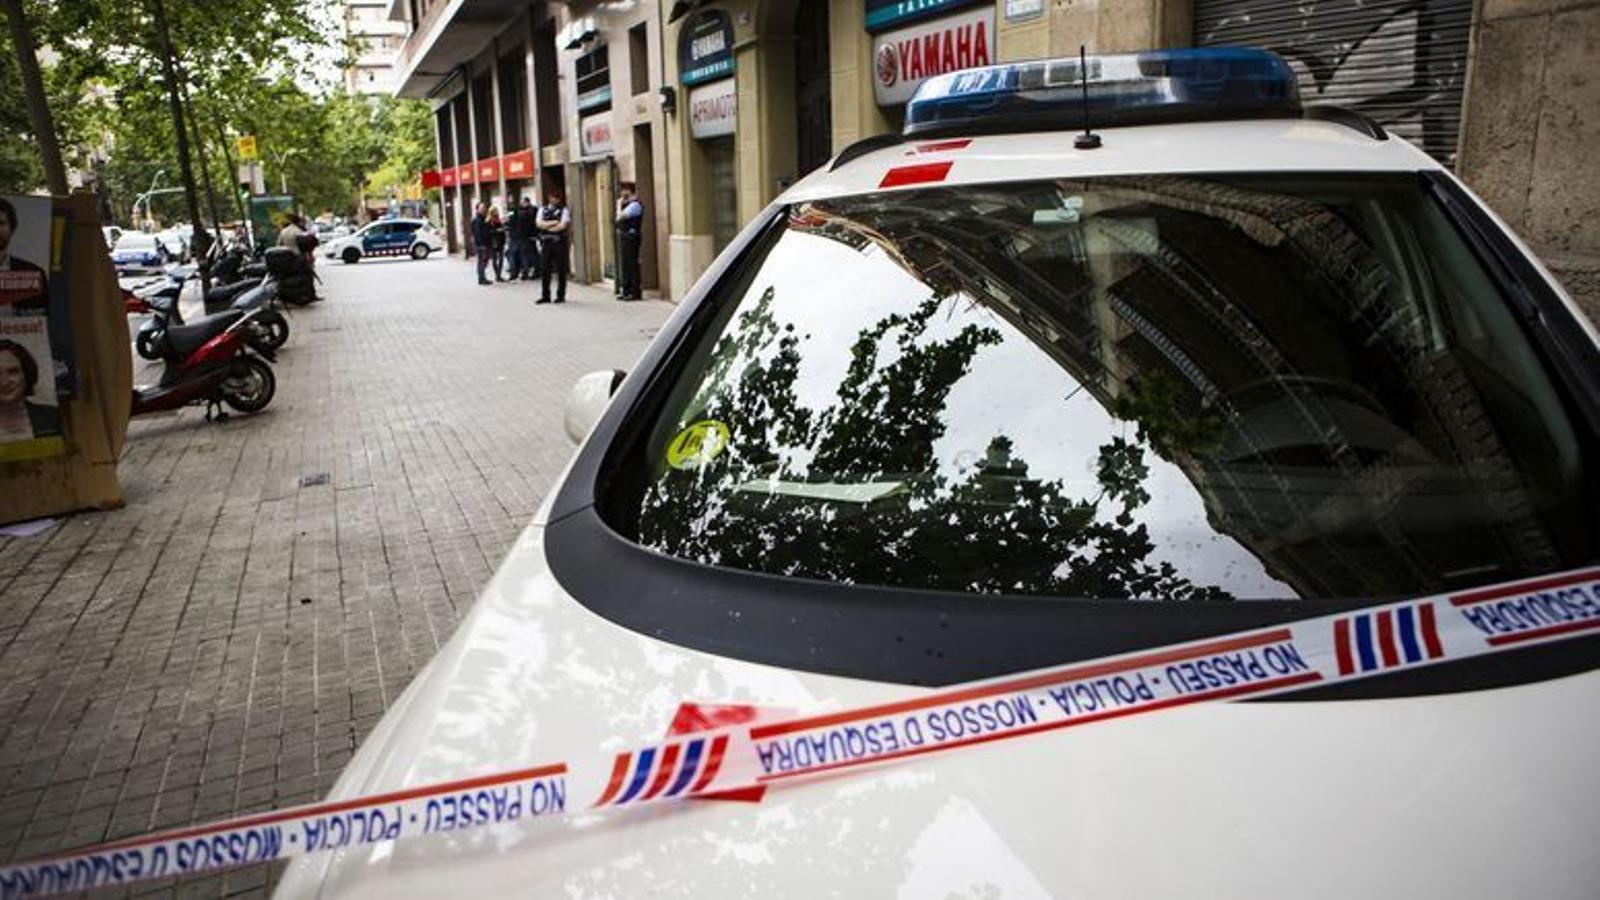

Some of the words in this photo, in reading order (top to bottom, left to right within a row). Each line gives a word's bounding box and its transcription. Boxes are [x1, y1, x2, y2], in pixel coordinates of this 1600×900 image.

[898, 20, 990, 82] YAMAHA
[1166, 652, 1263, 695] PASSEU
[1265, 643, 1309, 674] NO
[1050, 671, 1155, 716] POLICIA
[928, 694, 1038, 742] MOSSOS
[755, 716, 924, 774] D'ESQUADRA
[424, 786, 522, 834] PASSEU
[531, 779, 566, 817] NO
[303, 807, 402, 852] POLICIA
